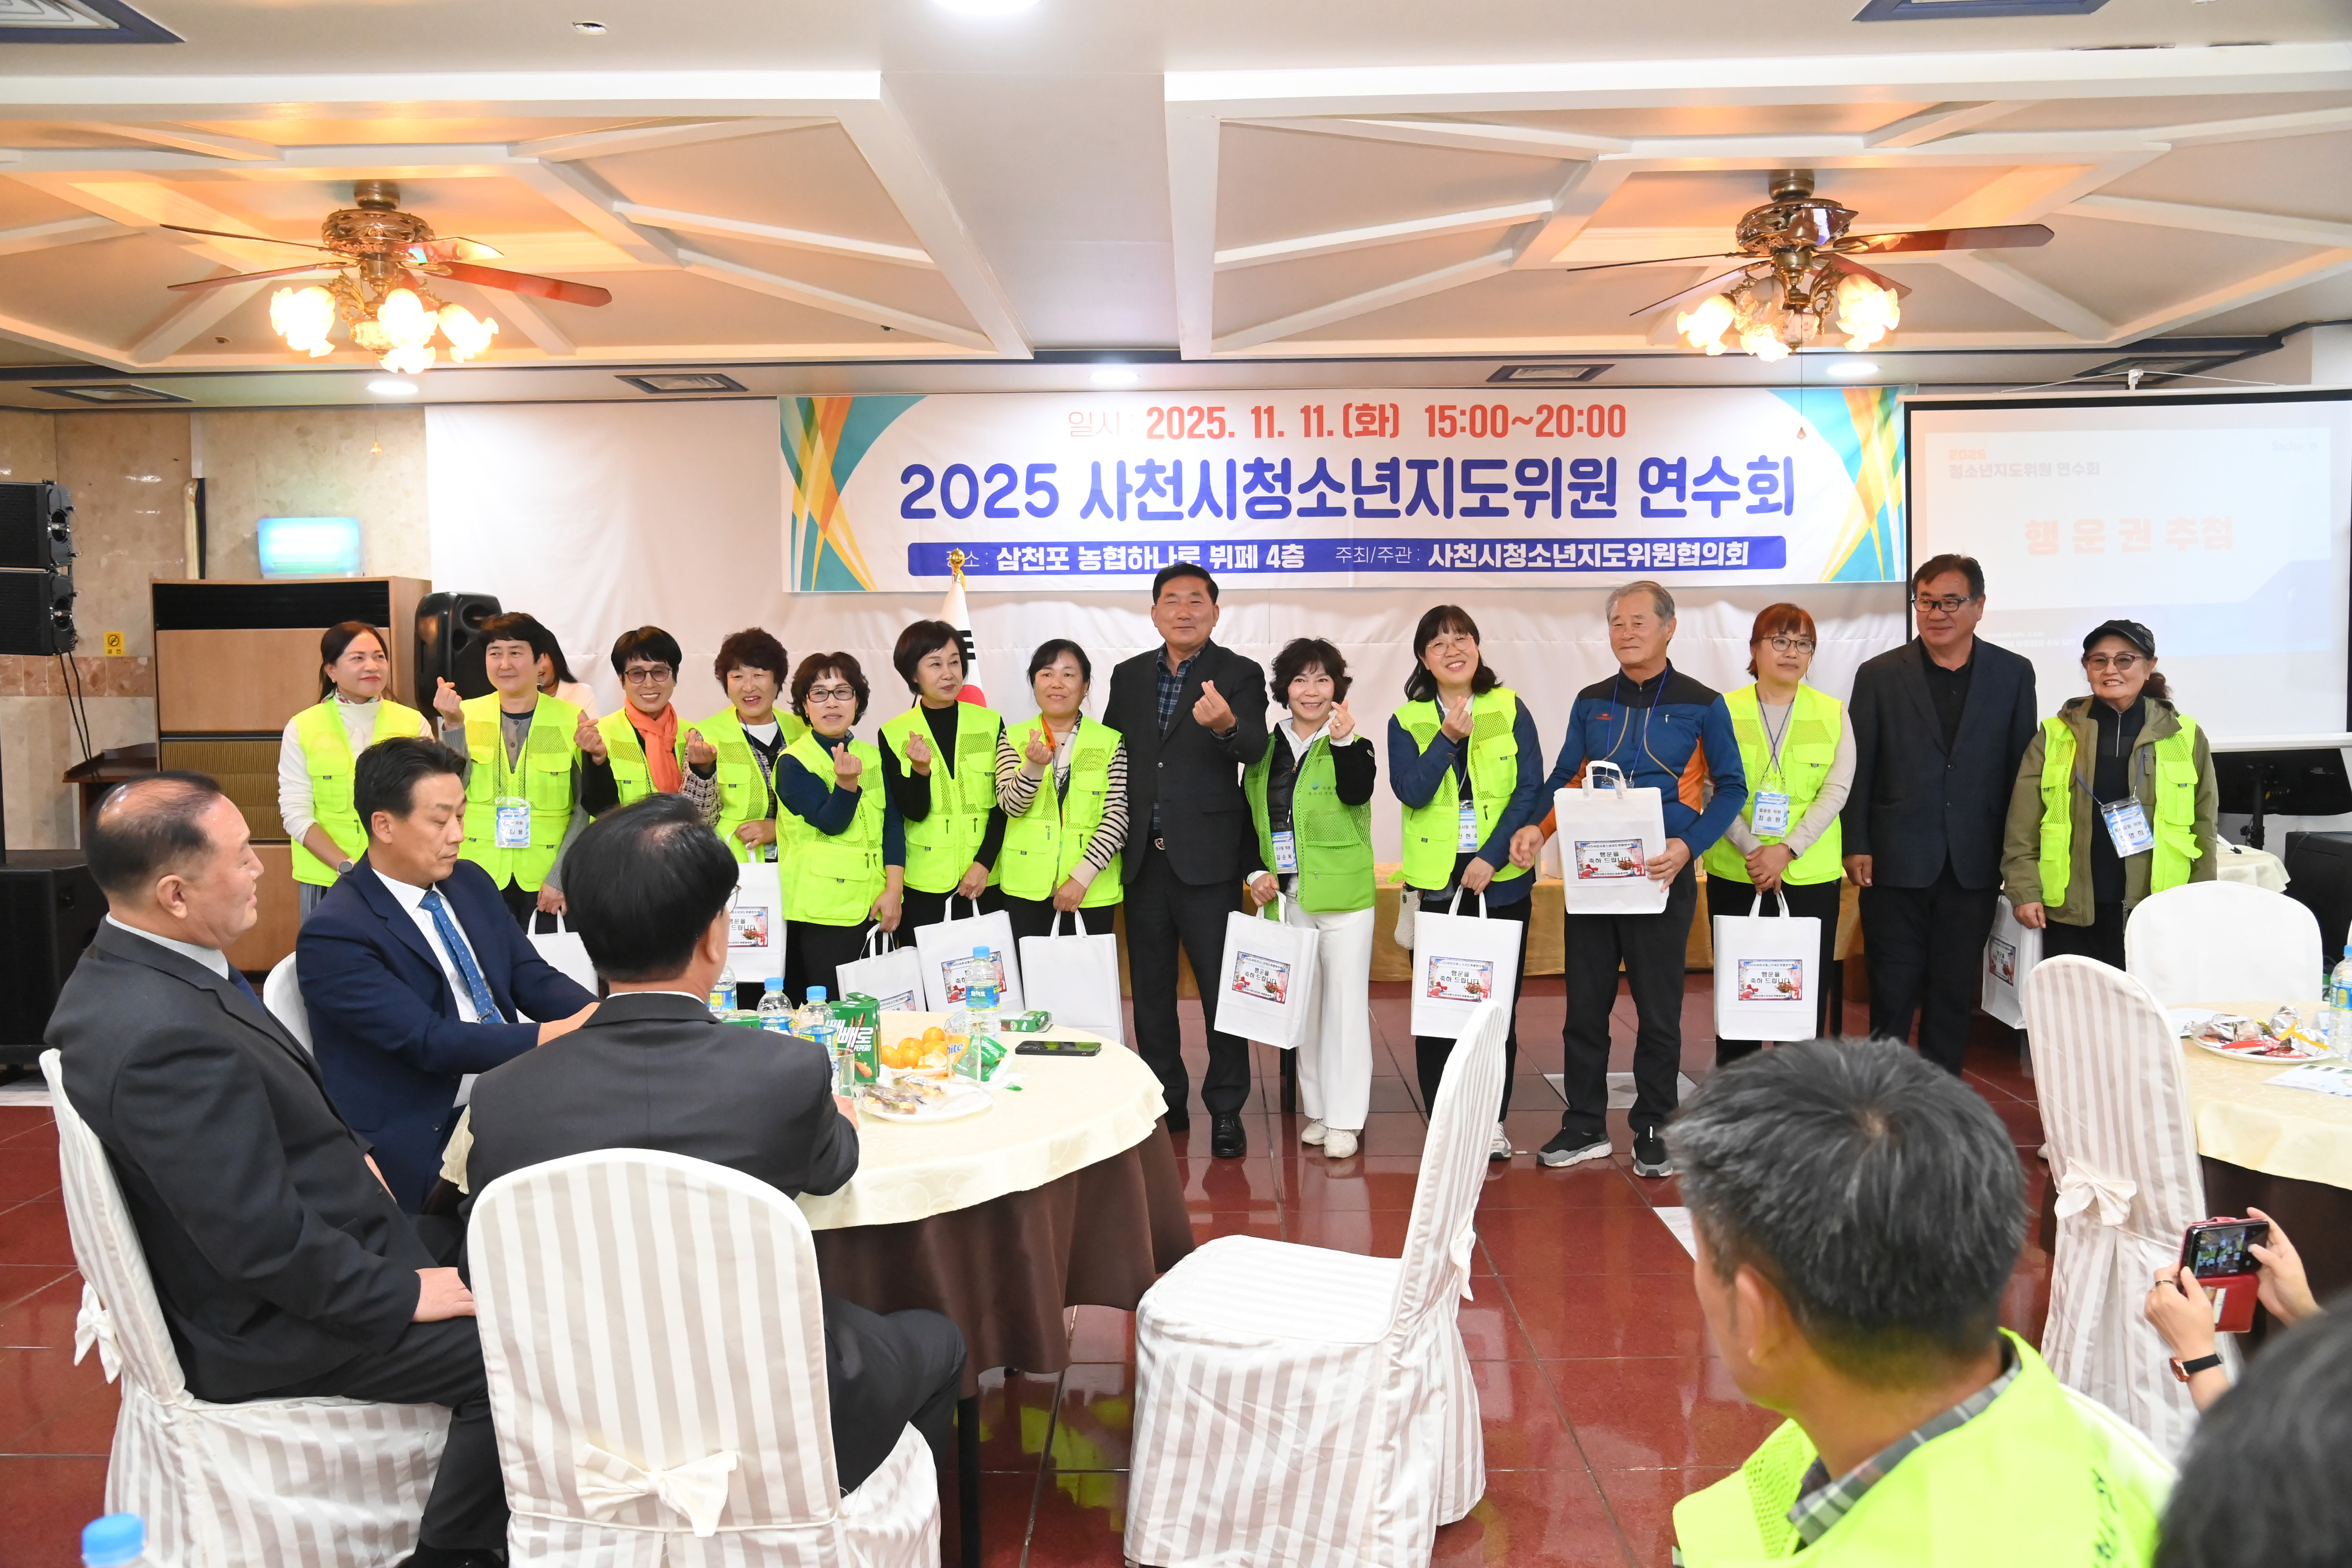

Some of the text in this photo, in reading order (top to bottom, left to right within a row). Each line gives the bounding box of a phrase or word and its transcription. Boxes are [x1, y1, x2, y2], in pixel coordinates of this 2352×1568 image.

[1068, 411, 1120, 437] 일시
[1147, 406, 1235, 440] 2025.
[1250, 405, 1285, 439] 11.
[1424, 403, 1627, 439] 15:00~20:00
[1948, 461, 2100, 479] 청소년지도위원 연수회
[901, 455, 1794, 522] 2025 사천시청소년지도위원 연수회
[2024, 515, 2234, 555] 행 운 권 추첨
[946, 550, 980, 567] 소
[996, 546, 1071, 572] 삼천포
[1078, 545, 1201, 571] 농협하나로
[1209, 544, 1258, 569] 뷔페
[1265, 544, 1305, 569] 4층
[1335, 545, 1413, 565] 주최/주관
[1428, 541, 1749, 568] 사천시청소년지도위원협의회
[1254, 967, 1269, 977] 행운을
[825, 1019, 874, 1049] 빼빼로
